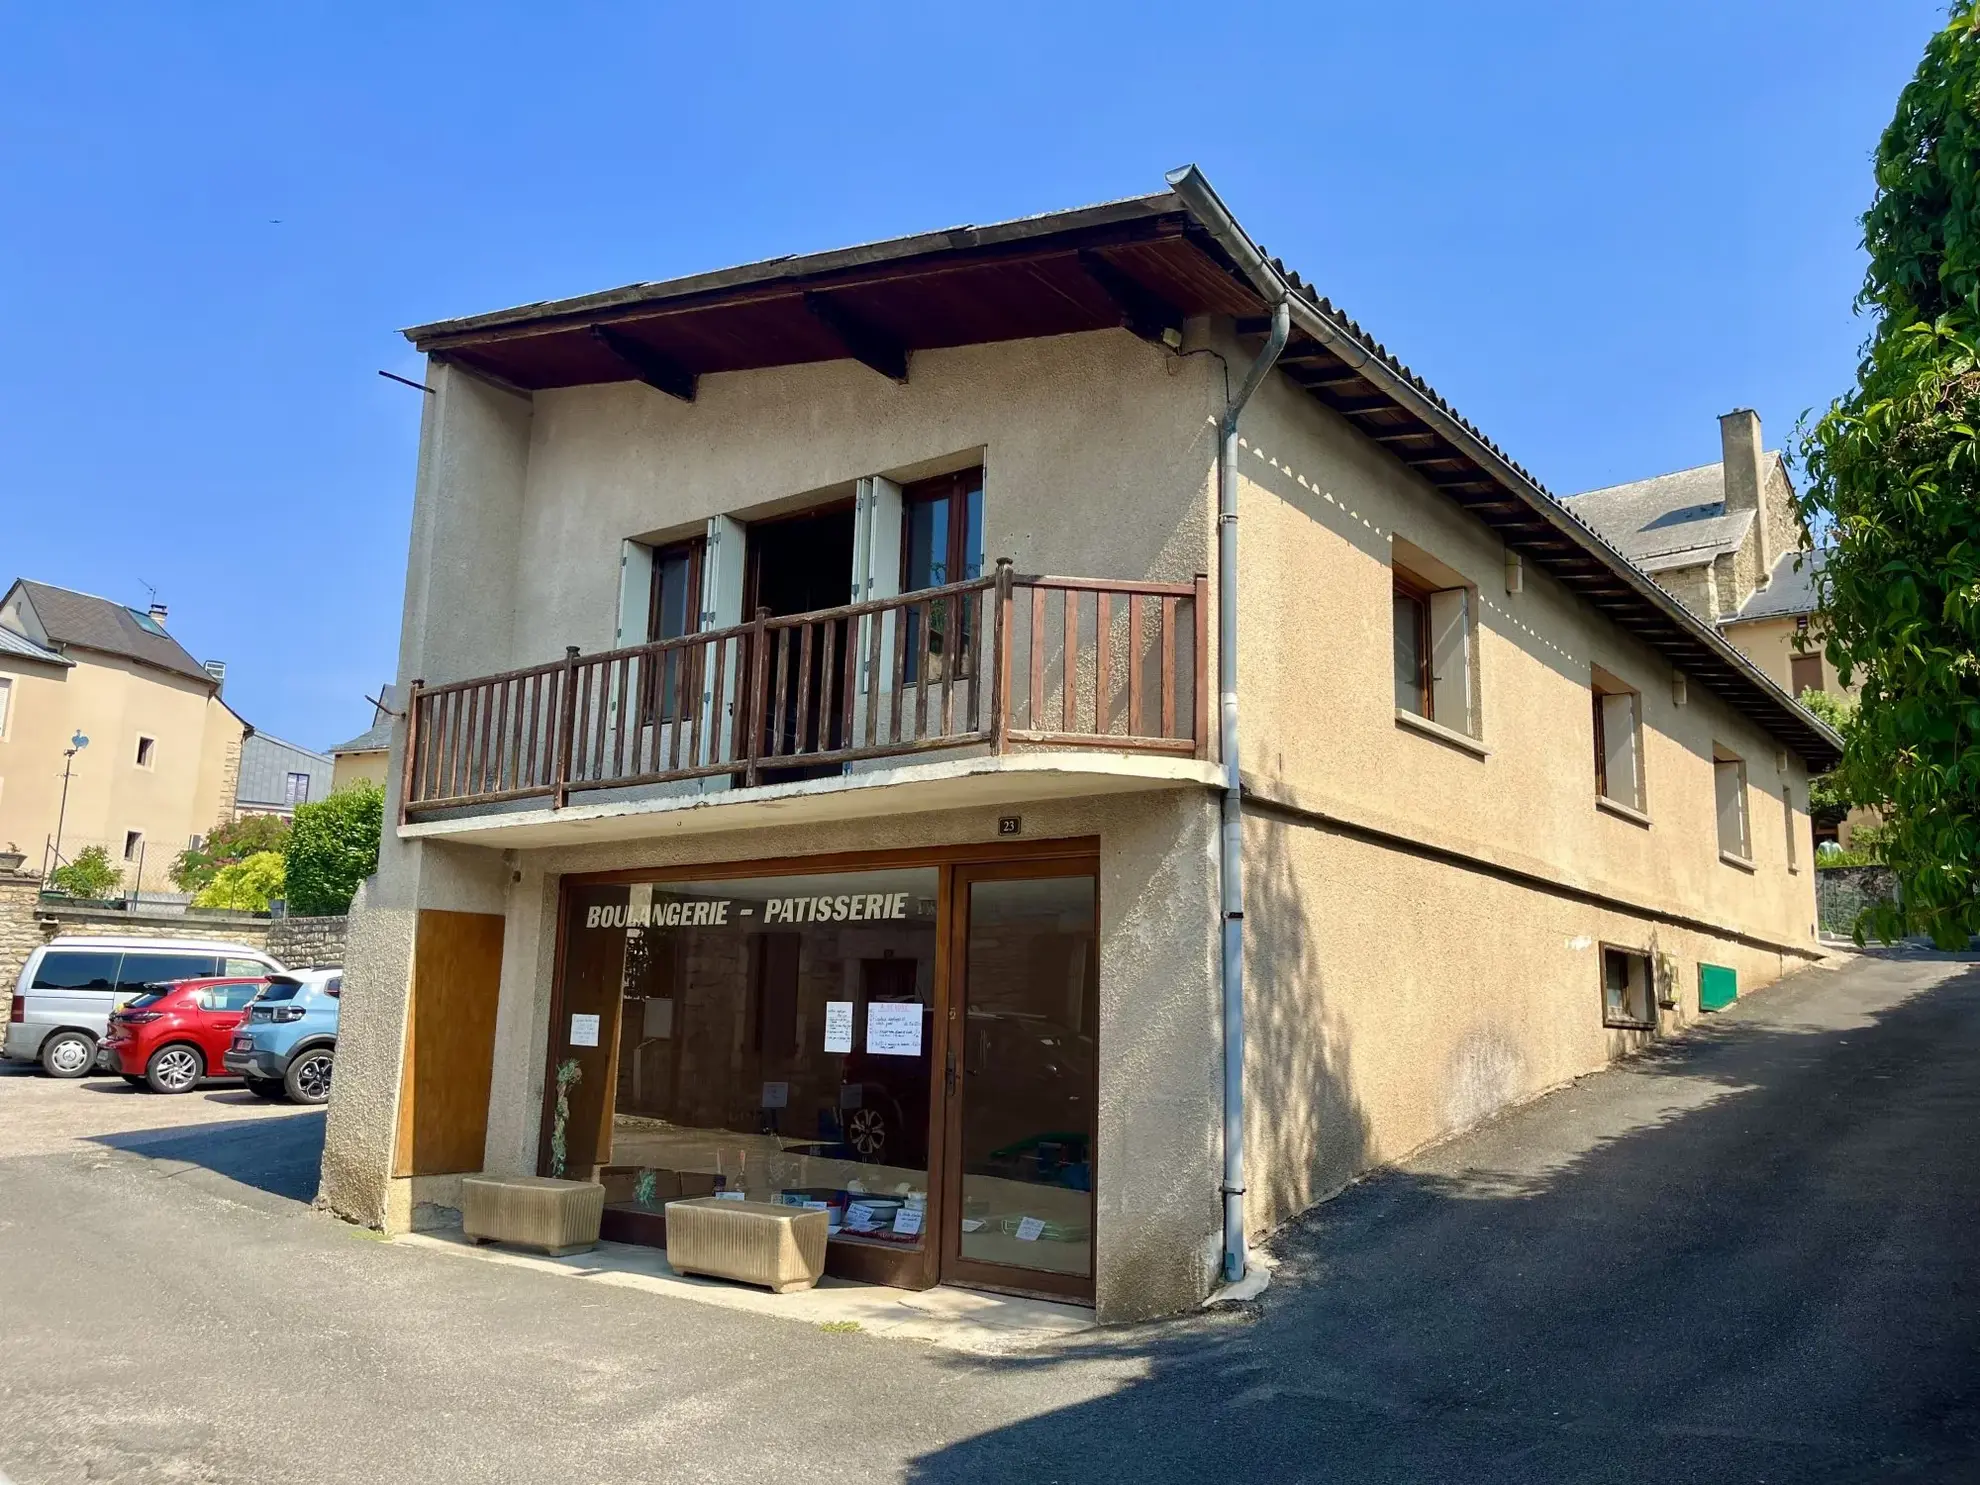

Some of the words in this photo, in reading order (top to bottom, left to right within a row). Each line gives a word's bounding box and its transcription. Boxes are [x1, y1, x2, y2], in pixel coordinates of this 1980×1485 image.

[1003, 820, 1015, 832] 23
[585, 900, 731, 929] BOULANGERIE
[763, 892, 909, 924] PATISSERIE
